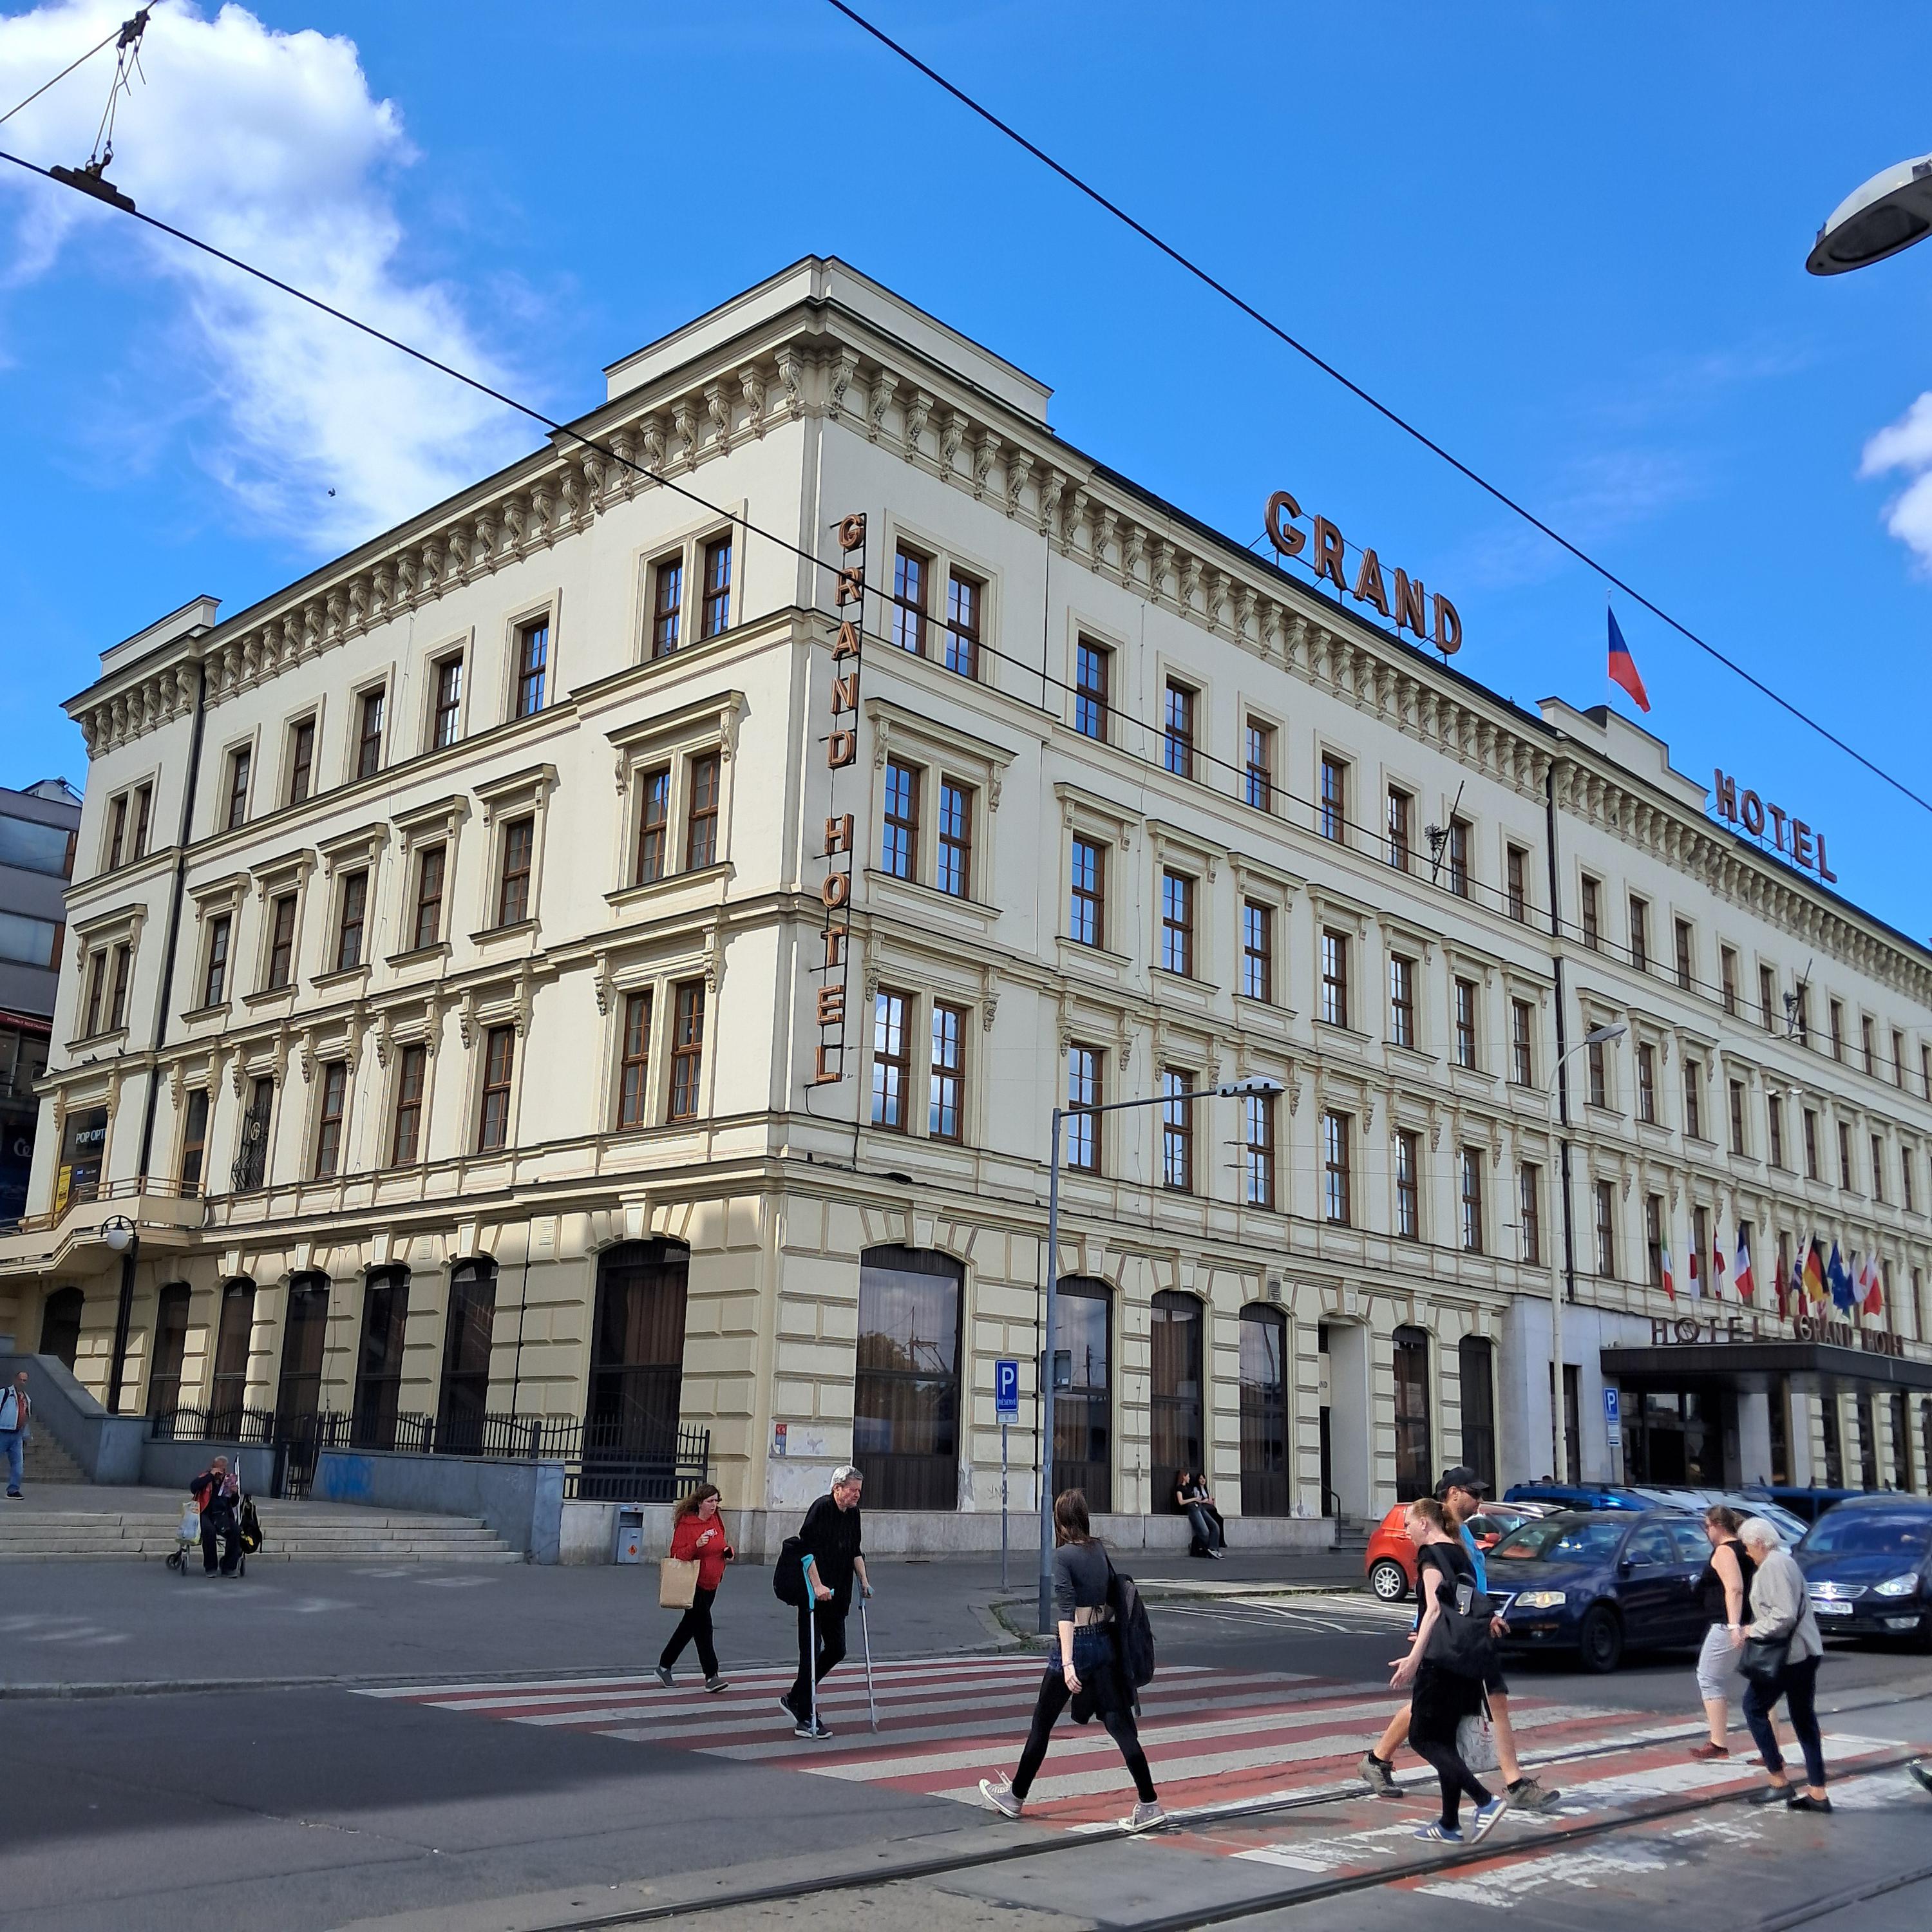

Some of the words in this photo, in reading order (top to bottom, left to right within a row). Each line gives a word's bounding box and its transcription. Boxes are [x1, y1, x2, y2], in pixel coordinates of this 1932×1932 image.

[827, 513, 865, 770] GRAND
[1264, 490, 1463, 654] GRAND
[1714, 768, 1837, 884] HOTEL
[814, 813, 855, 1085] HOTEL
[75, 1132, 90, 1144] POP
[1651, 1316, 1781, 1345] HOTEL
[1793, 1314, 1854, 1349] GRAND
[1002, 1367, 1014, 1396] P
[1607, 1392, 1616, 1412] P
